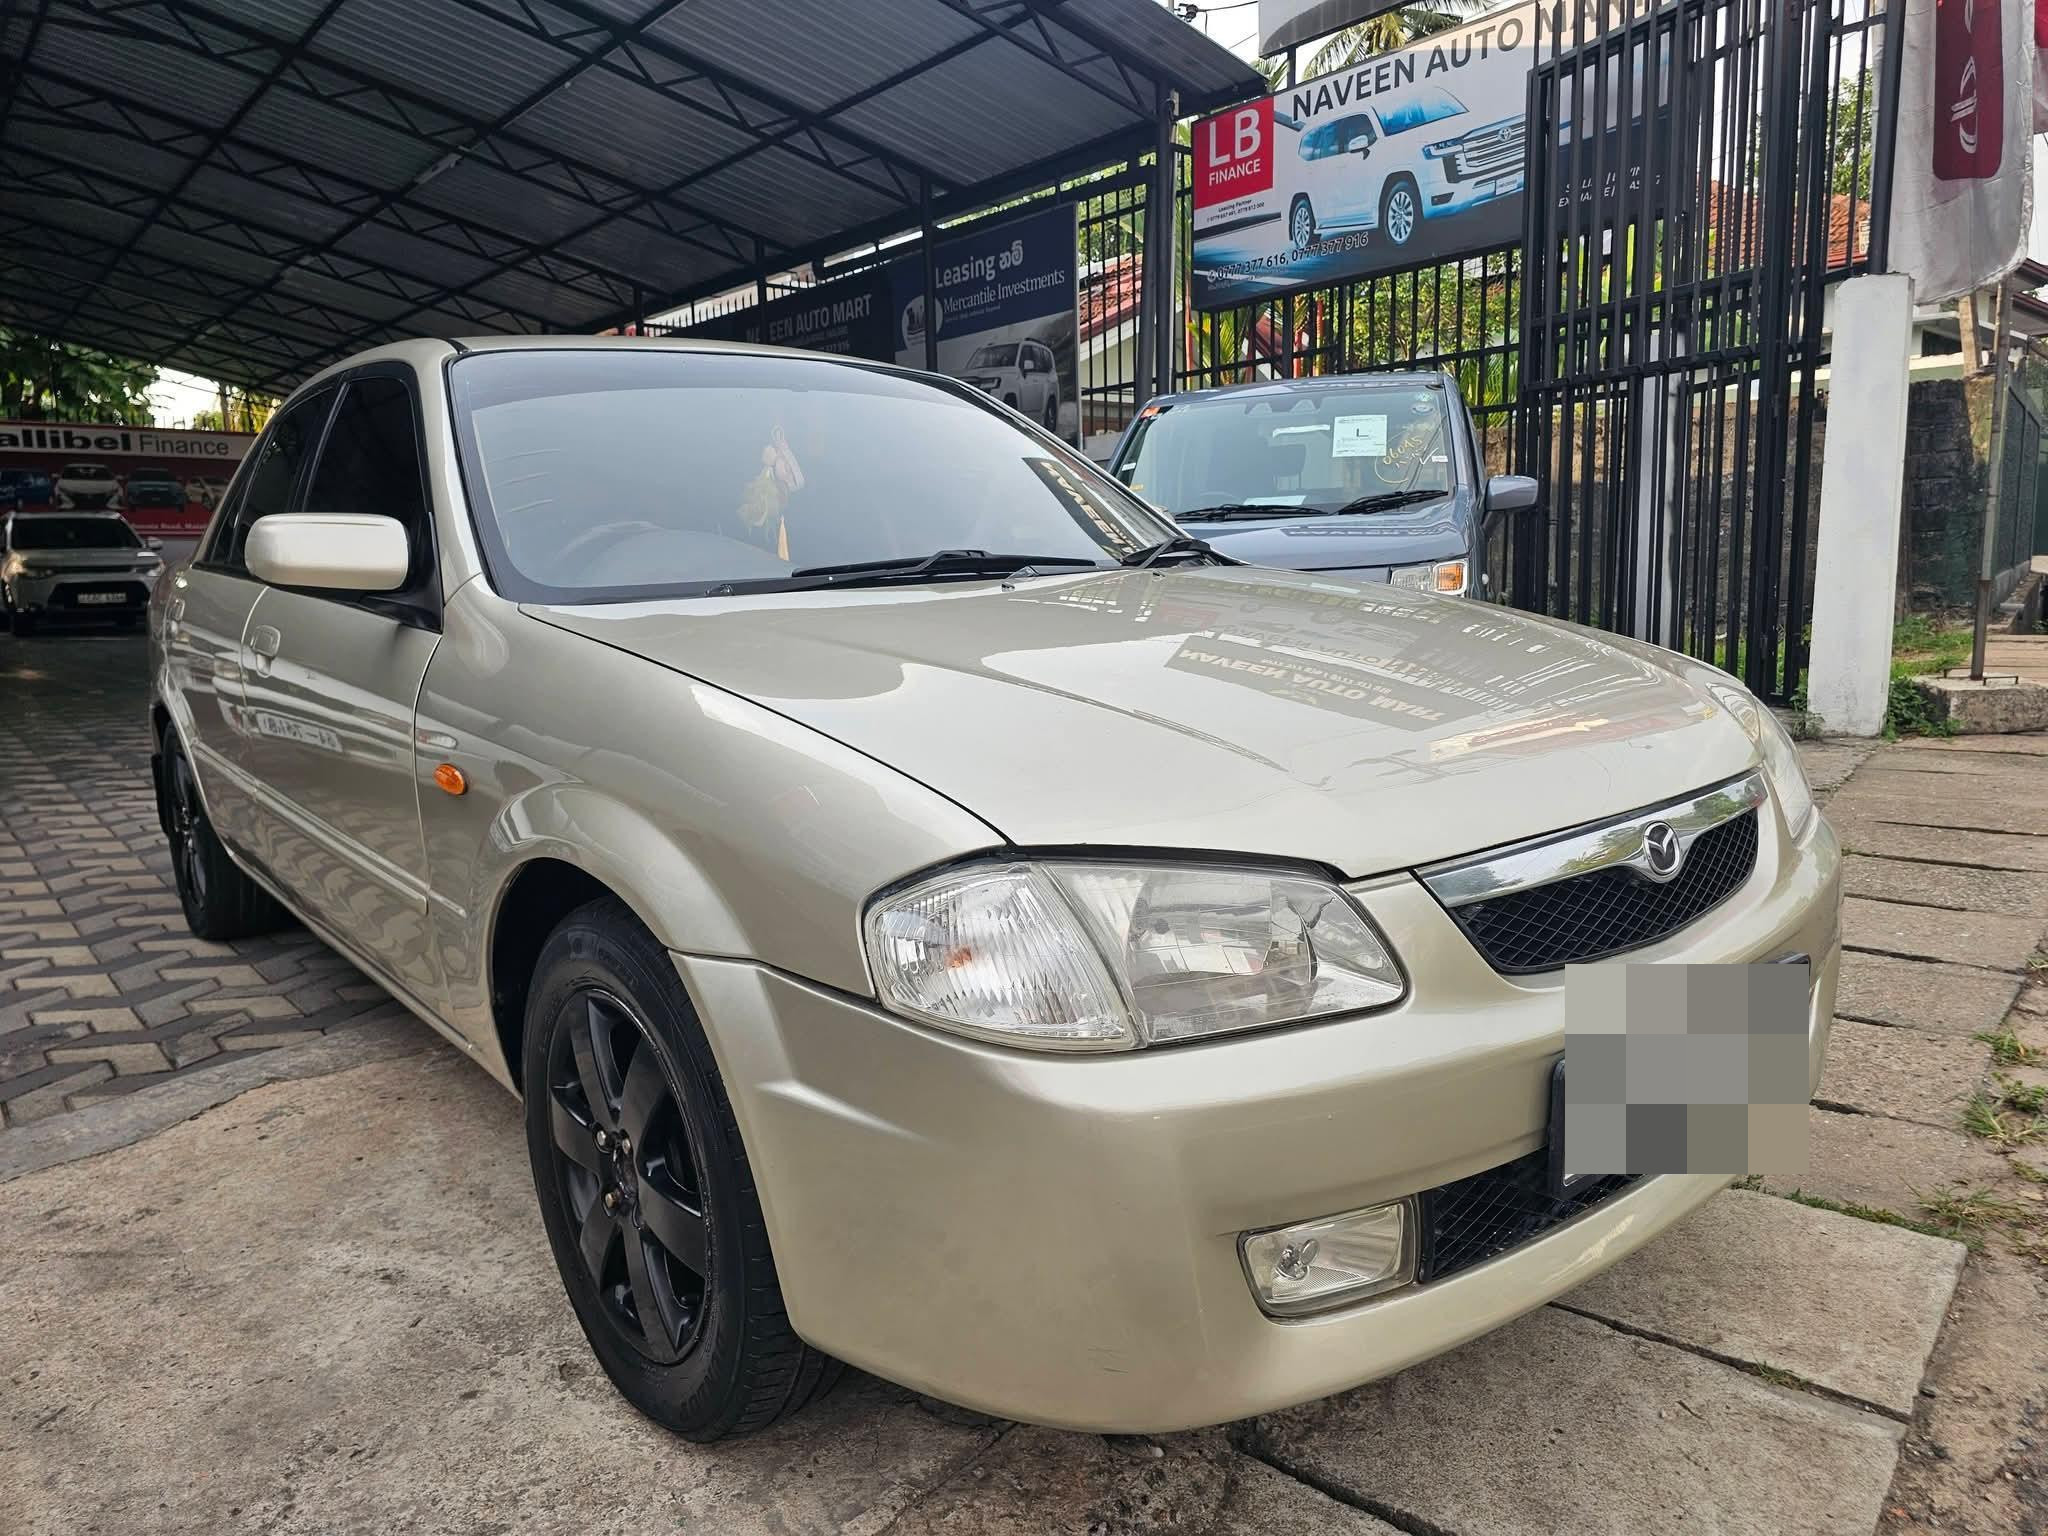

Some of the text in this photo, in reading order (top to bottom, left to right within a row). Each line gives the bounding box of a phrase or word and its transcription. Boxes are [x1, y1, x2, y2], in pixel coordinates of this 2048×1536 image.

[1292, 53, 1415, 121] NAVEEN
[1425, 18, 1523, 78] AUTO
[1208, 108, 1261, 168] LB
[1208, 158, 1261, 187] FINANCE
[935, 255, 996, 289] Leasing
[1217, 231, 1369, 280] 0777 377 616, 0777 377 916
[943, 269, 1065, 313] Mercantile Investments
[795, 306, 830, 335] AUTO
[832, 293, 872, 324] MART
[139, 434, 229, 455] Finance
